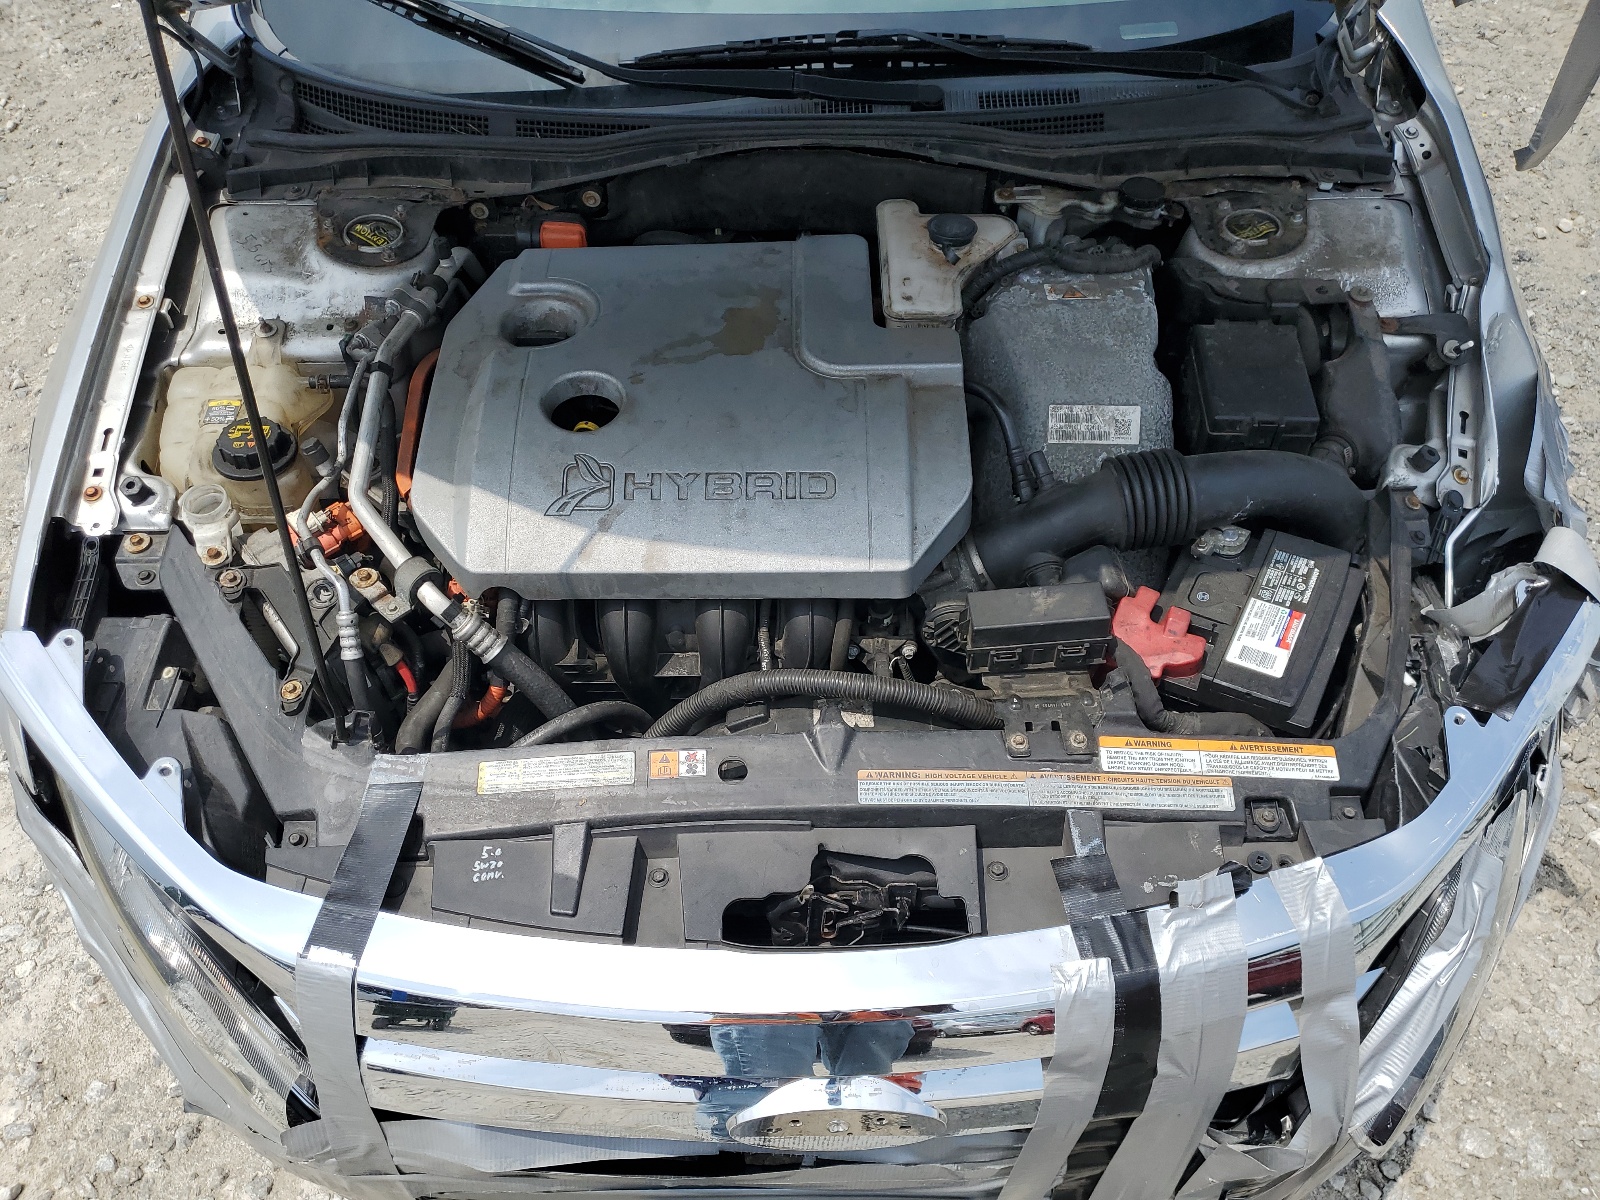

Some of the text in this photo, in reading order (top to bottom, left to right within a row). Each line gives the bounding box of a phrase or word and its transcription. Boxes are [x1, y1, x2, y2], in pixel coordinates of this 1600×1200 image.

[623, 471, 837, 500] HYBRID
[1134, 740, 1172, 748] WARNING
[1240, 746, 1304, 754] AVERTISSEMENT
[874, 771, 921, 779] WARNING:
[480, 845, 502, 859] 5.0
